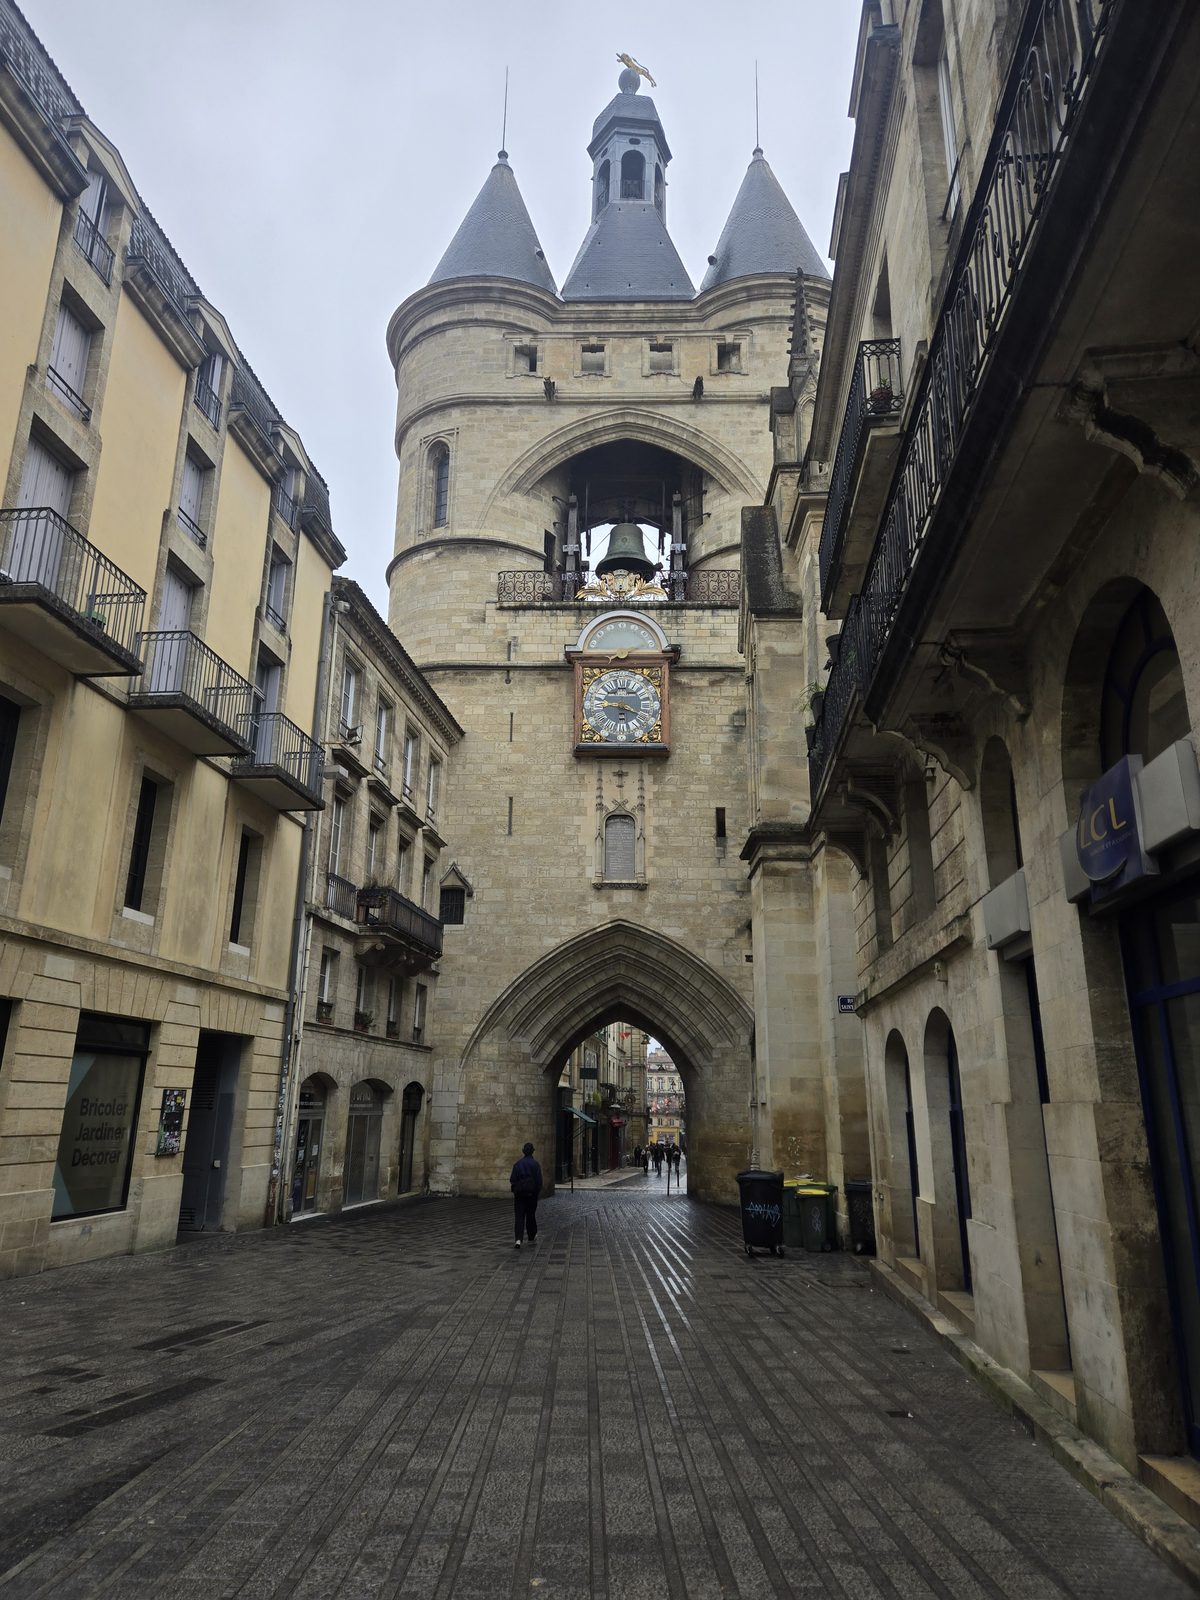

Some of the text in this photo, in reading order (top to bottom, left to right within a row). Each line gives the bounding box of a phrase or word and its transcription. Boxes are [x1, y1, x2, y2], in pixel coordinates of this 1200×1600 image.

[1080, 797, 1127, 849] LCL
[80, 1098, 128, 1116] Bricoler
[75, 1122, 127, 1141] Jardiner
[72, 1147, 121, 1167] Décorer
